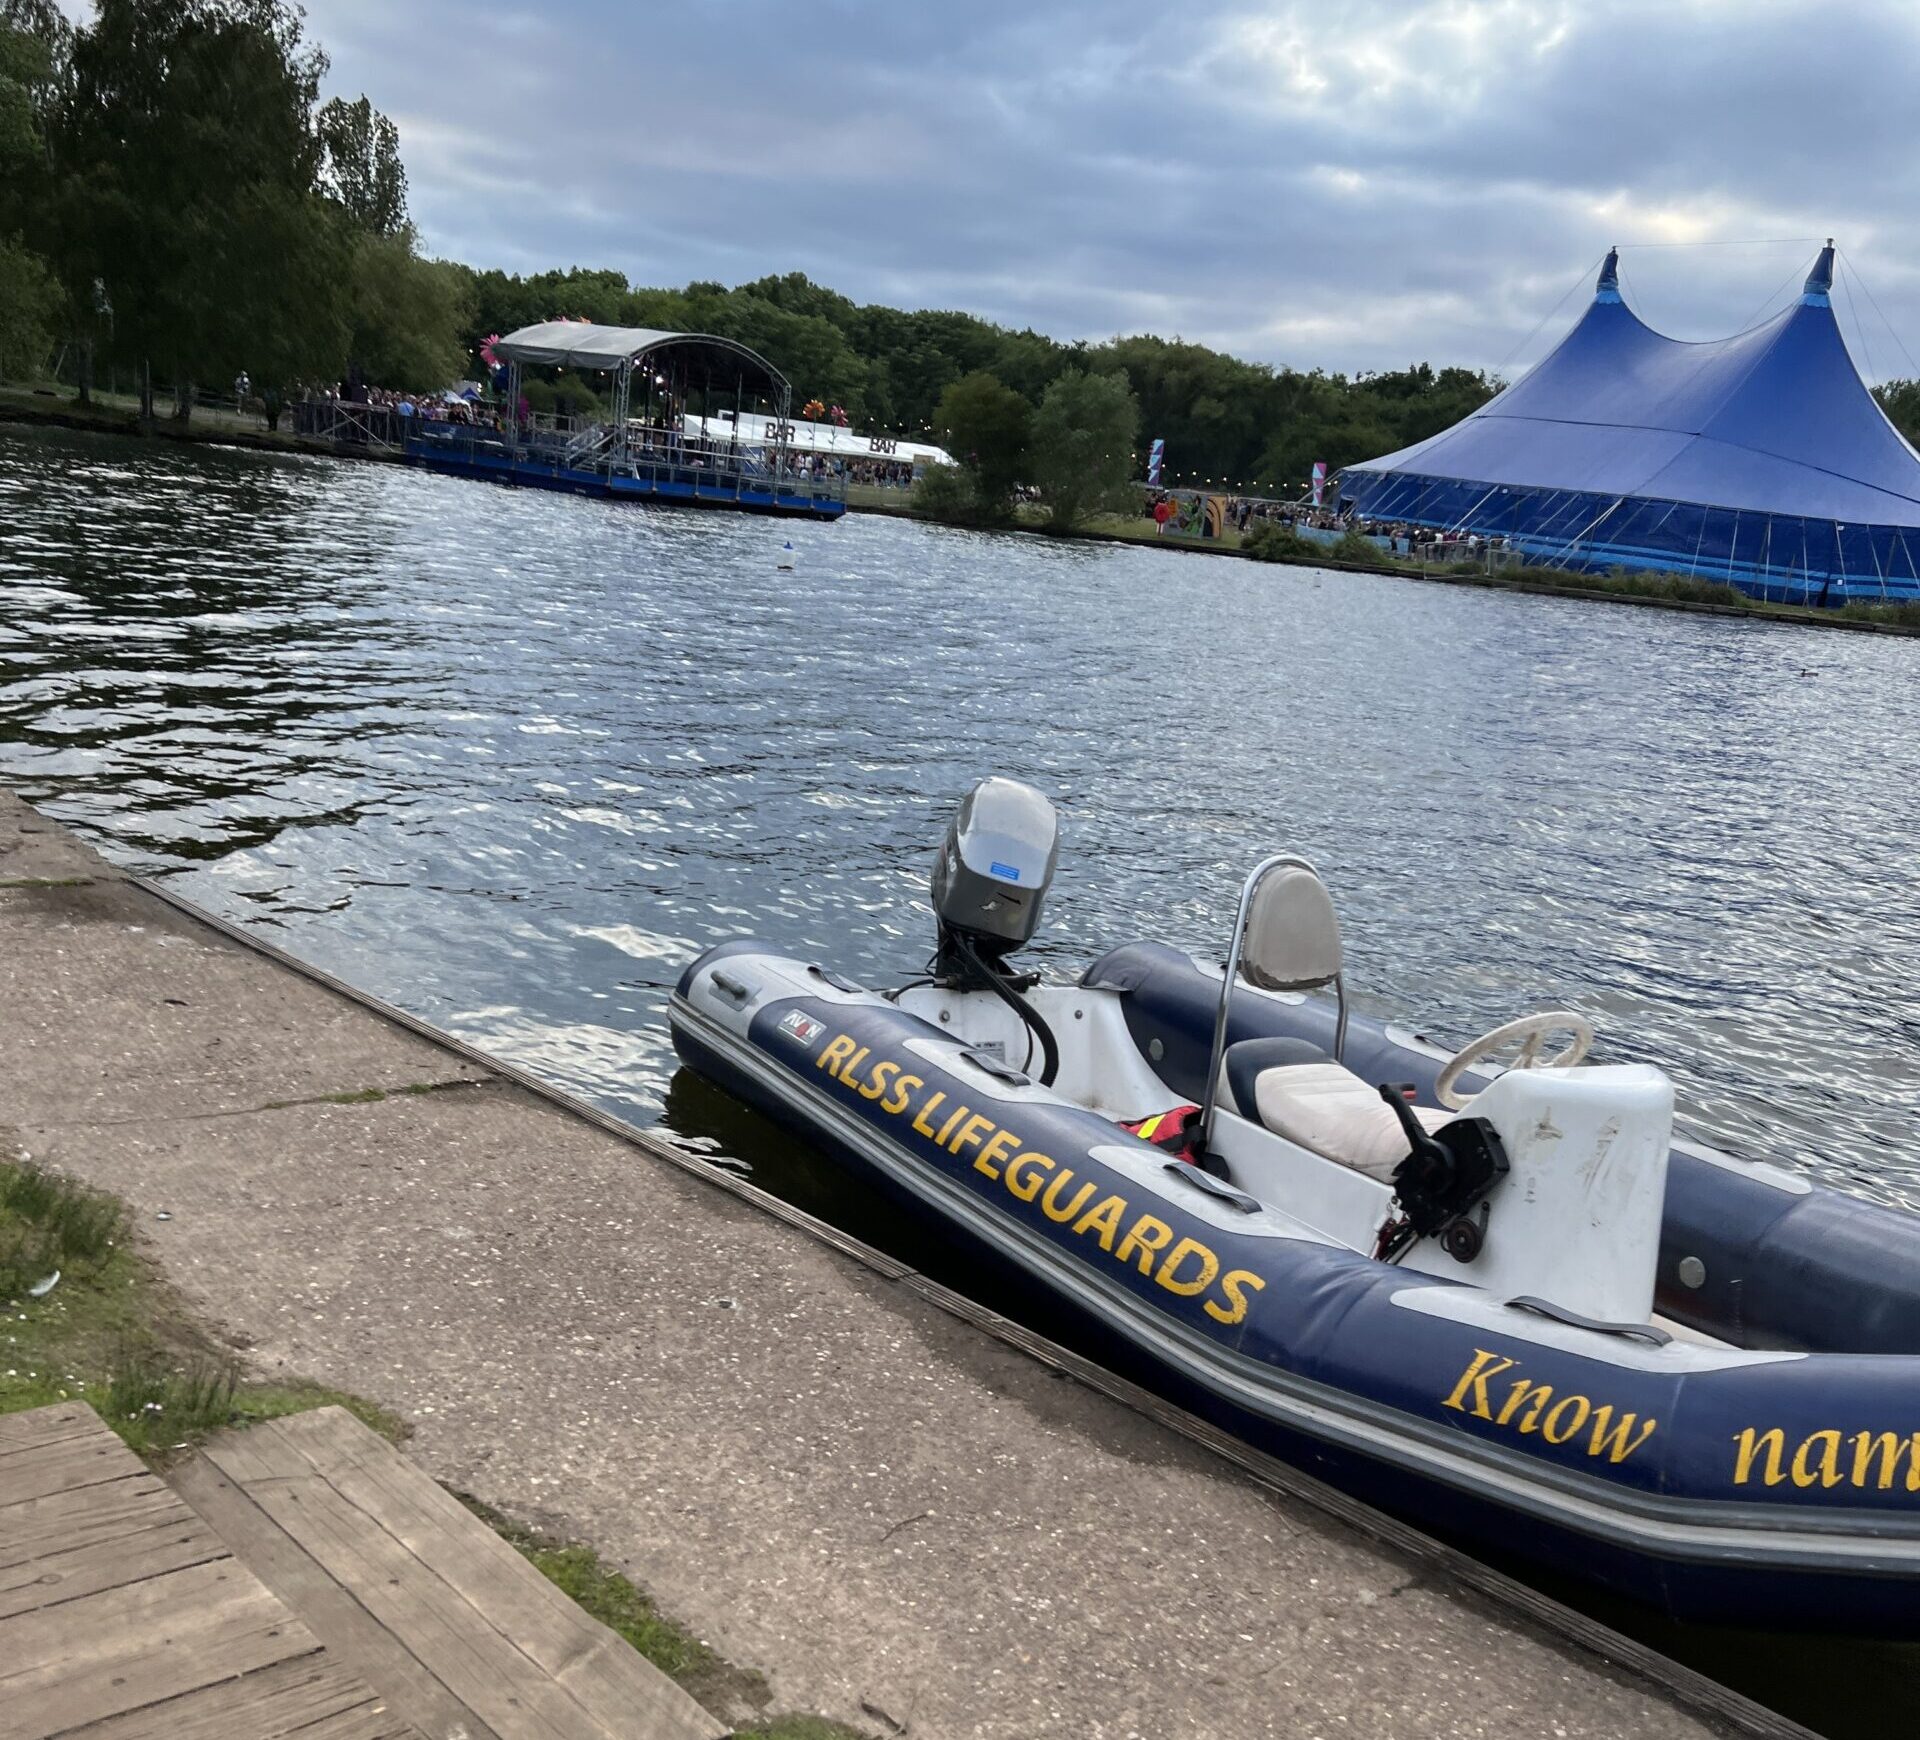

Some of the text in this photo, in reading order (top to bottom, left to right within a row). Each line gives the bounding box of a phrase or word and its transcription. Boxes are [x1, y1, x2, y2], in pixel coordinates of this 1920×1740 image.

[765, 422, 796, 443] BAR
[869, 437, 897, 455] BAR
[783, 1012, 822, 1038] AVON
[815, 1033, 1266, 1325] RLSS LIFEGUARDS
[1441, 1348, 1658, 1464] Know
[1732, 1427, 1920, 1492] nam
